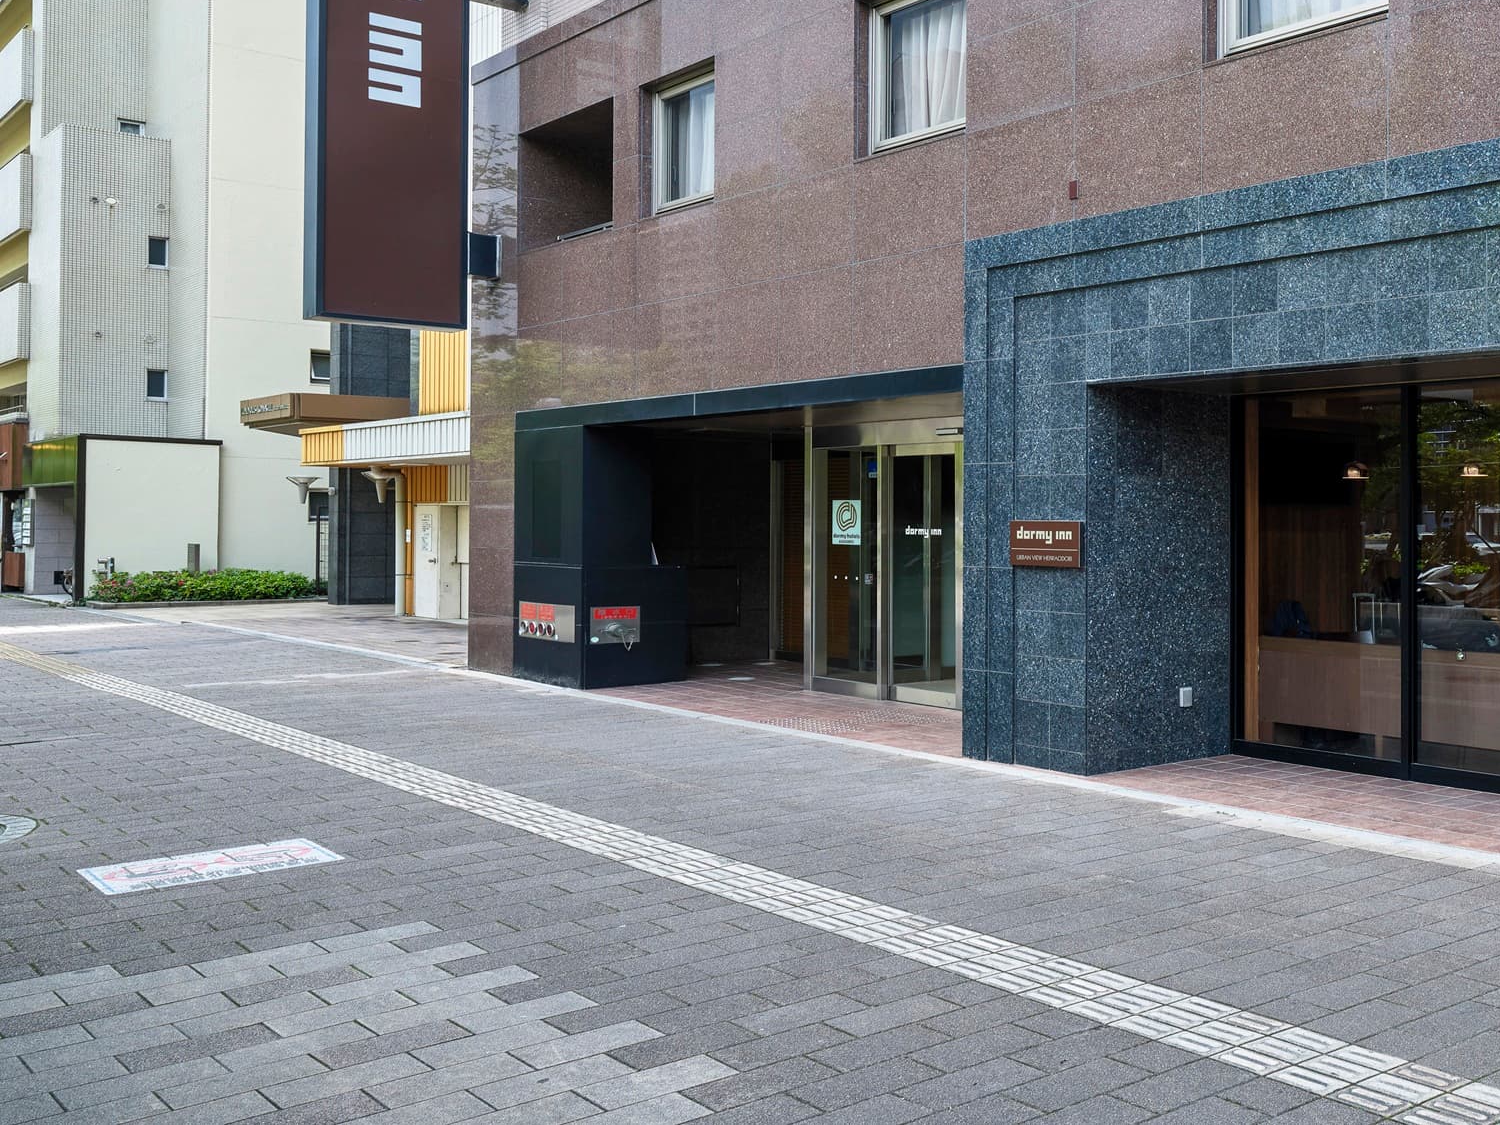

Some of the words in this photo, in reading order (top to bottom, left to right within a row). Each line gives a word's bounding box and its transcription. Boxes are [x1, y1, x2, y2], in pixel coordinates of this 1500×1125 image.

[367, 10, 423, 109] inn
[905, 525, 929, 538] dormy
[1016, 526, 1053, 544] dormy
[1055, 530, 1072, 540] inn
